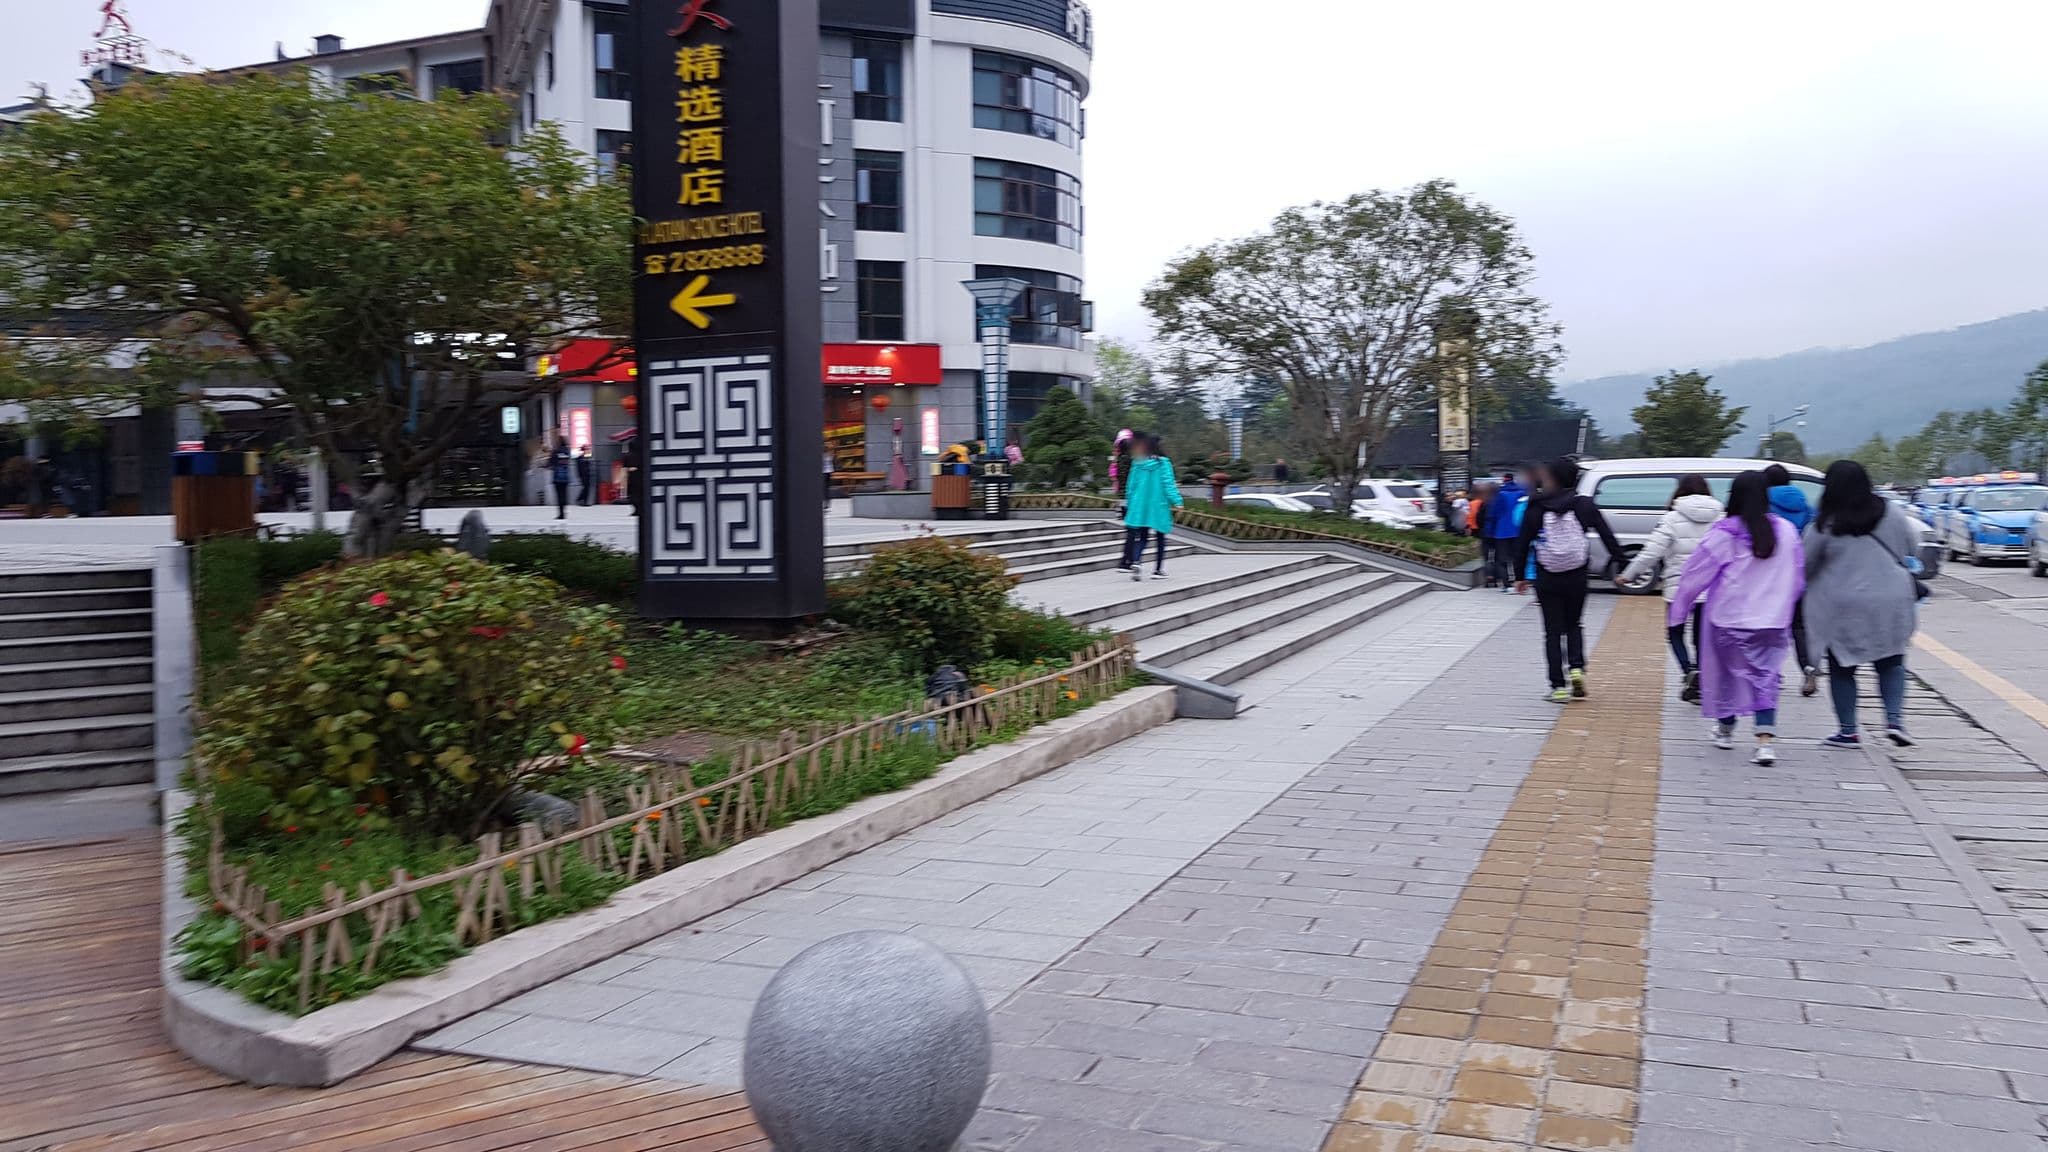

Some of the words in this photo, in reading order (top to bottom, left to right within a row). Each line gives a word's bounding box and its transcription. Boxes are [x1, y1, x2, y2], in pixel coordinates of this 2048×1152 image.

[674, 43, 724, 206] 精选酒店
[669, 244, 765, 273] 2828888
